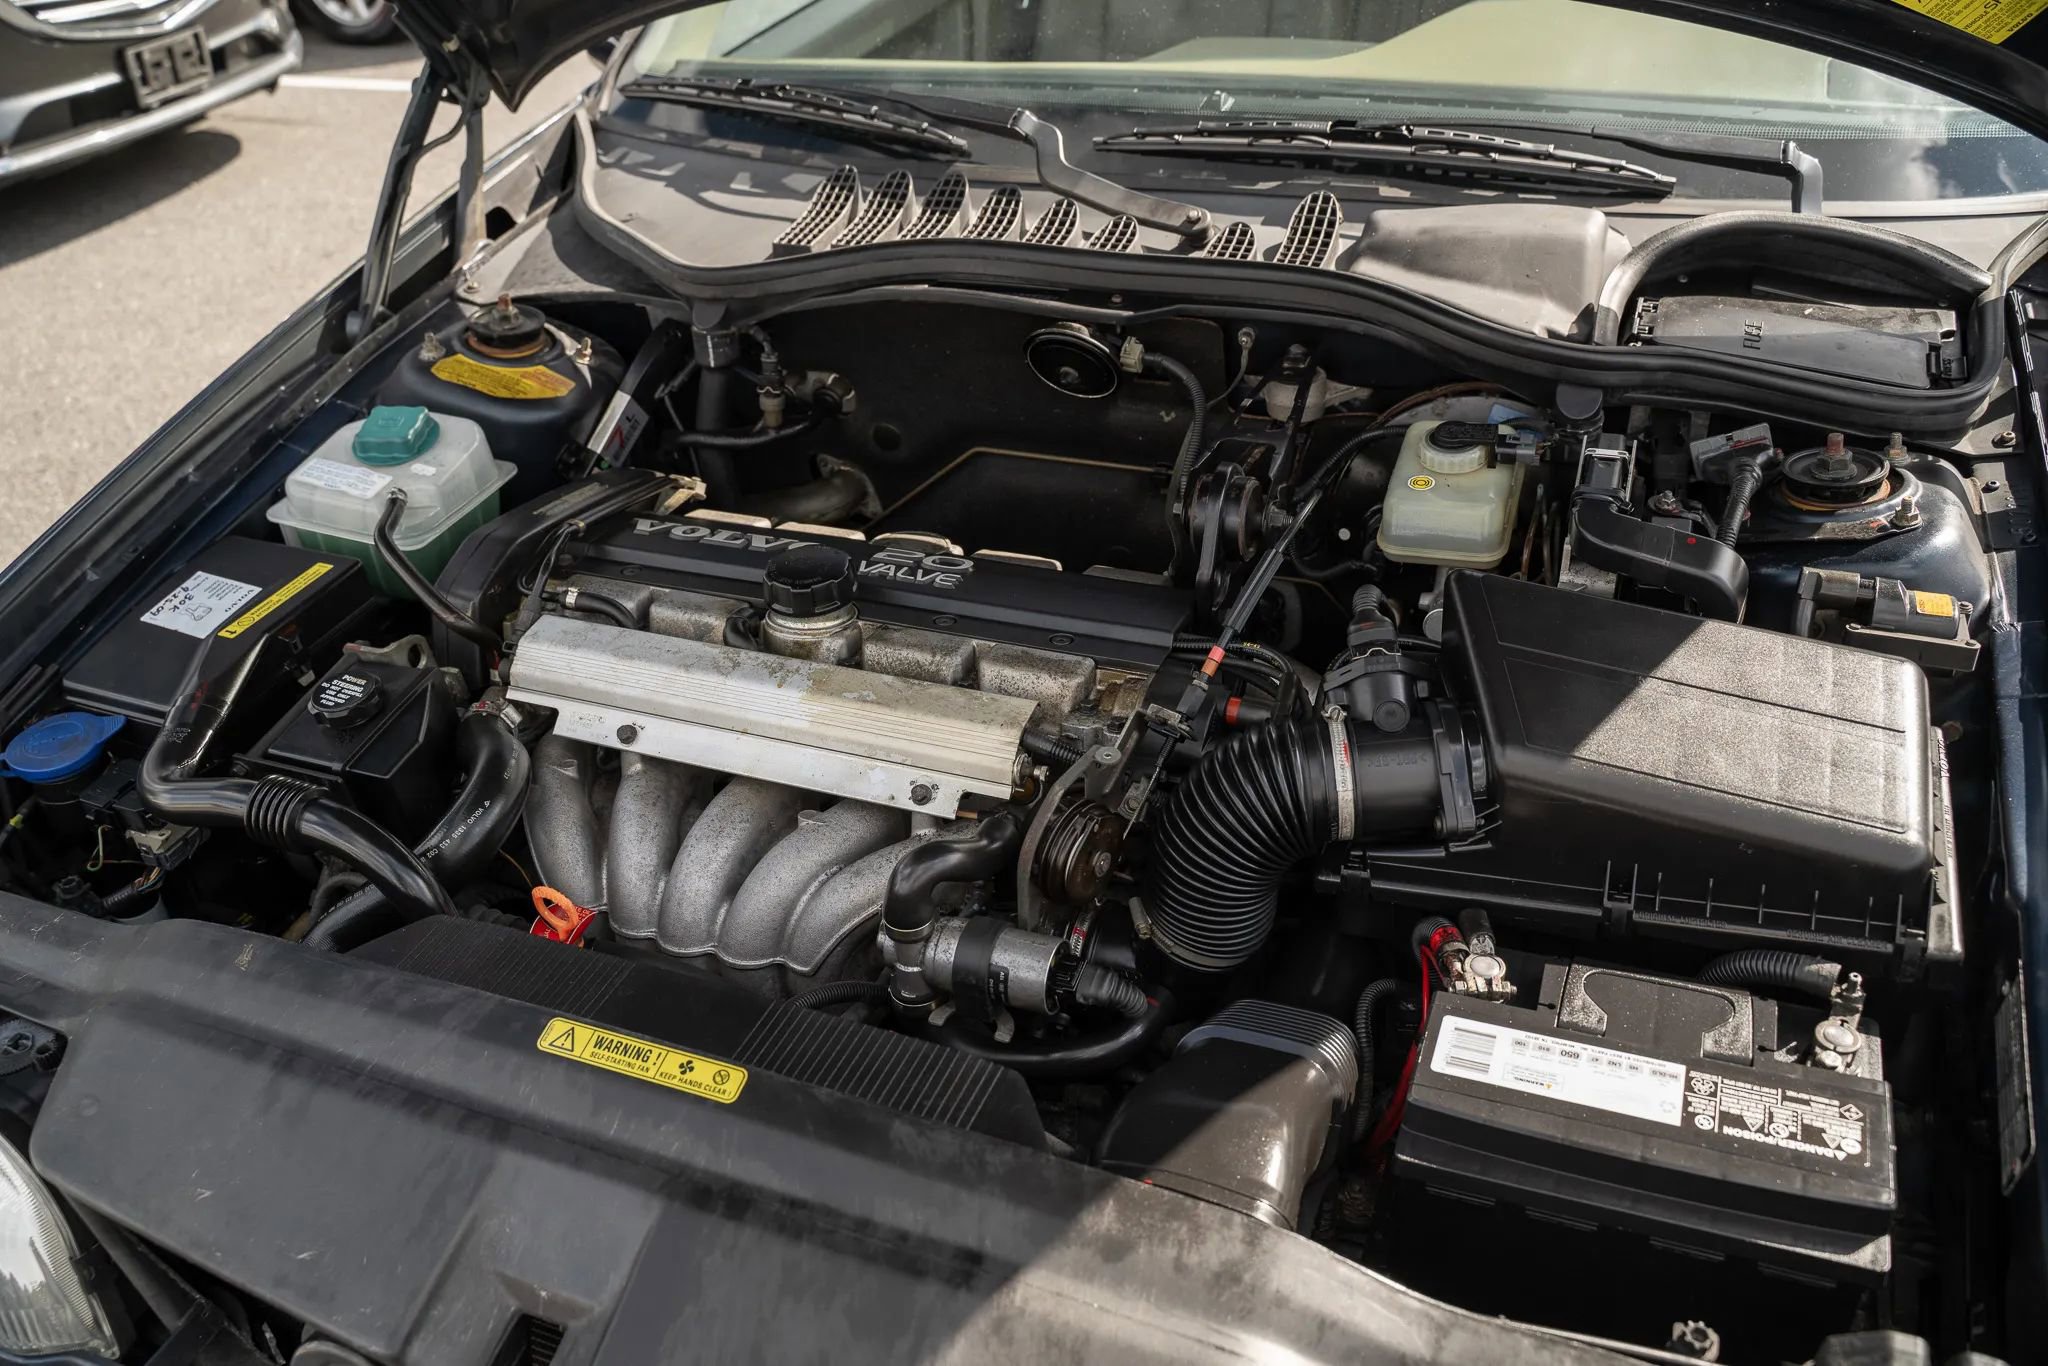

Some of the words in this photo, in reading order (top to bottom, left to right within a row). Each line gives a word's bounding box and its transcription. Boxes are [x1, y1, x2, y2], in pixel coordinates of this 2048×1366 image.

[1742, 319, 1764, 350] FUSE
[633, 517, 821, 552] VOLV
[872, 547, 974, 572] 20
[858, 559, 964, 589] VALVE
[225, 590, 254, 612] VOLVO
[332, 680, 364, 692] STEERING
[342, 674, 367, 686] POWER
[320, 694, 346, 704] APPROVED
[467, 808, 484, 824] VOLVO
[592, 1034, 653, 1062] WARNING
[1560, 1049, 1580, 1060] 650
[589, 1050, 637, 1071] SELF-STARTING
[636, 1063, 650, 1074] FAN
[659, 1071, 676, 1082] KEEP
[678, 1076, 704, 1089] HANDS
[704, 1083, 727, 1096] CLEAR
[1722, 1125, 1835, 1159] DANGER/POISON
